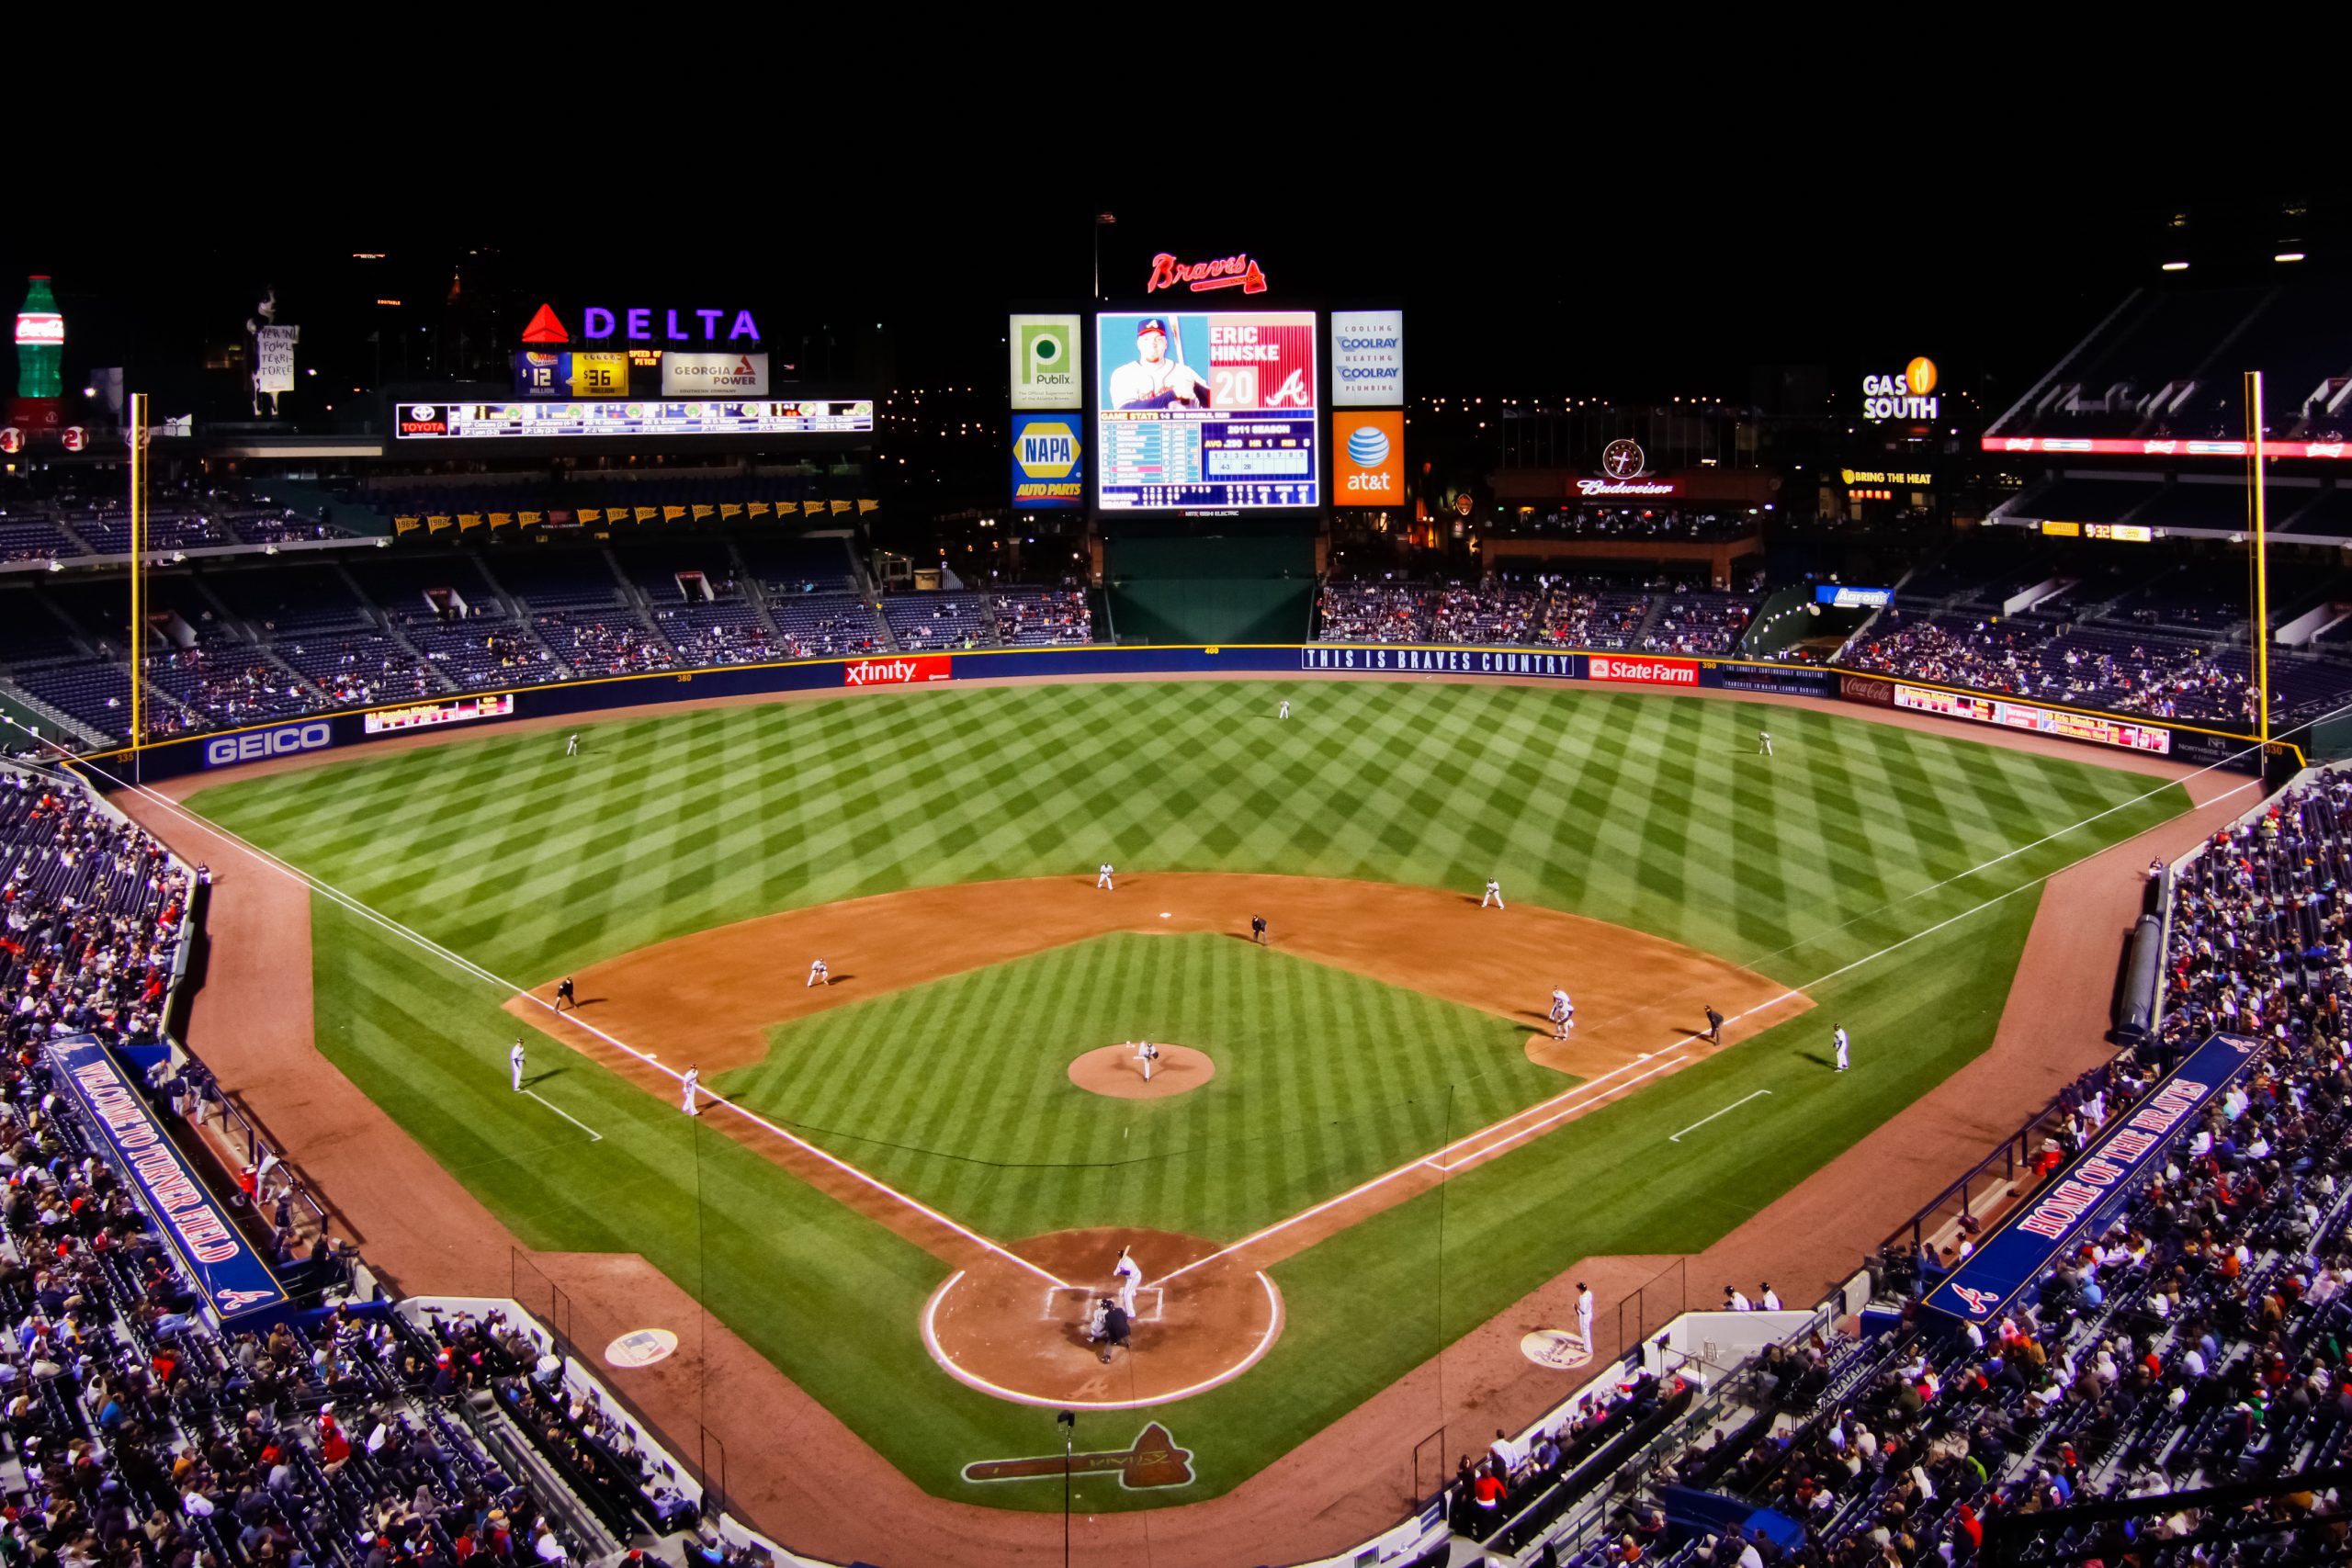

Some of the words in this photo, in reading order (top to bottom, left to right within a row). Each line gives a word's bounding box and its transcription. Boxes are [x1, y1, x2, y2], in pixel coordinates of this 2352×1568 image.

[1148, 254, 1246, 293] Braves
[584, 307, 760, 340] DELTA
[1210, 327, 1258, 344] ERIC
[1341, 338, 1399, 348] COOLRAY
[264, 341, 292, 352] FOWL
[1210, 344, 1279, 361] HINSKE
[534, 368, 551, 386] 12
[674, 366, 730, 376] GEORGIA
[1036, 374, 1070, 385] Publix
[1341, 367, 1399, 378] COOLRAY
[713, 377, 756, 385] POWER
[1215, 369, 1254, 404] 20
[1863, 375, 1907, 396] GAS
[1863, 397, 1938, 420] SOUTH
[401, 423, 446, 432] TOYOTA
[1251, 424, 1290, 434] SEASON
[0, 432, 22, 449] 41
[63, 430, 87, 447] 21
[1025, 438, 1070, 463] NAPA
[1347, 471, 1390, 491] at&t
[1855, 471, 1884, 482] BRING
[1887, 472, 1905, 483] THE
[1906, 473, 1931, 484] HEAT
[1016, 483, 1046, 496] AUTO
[1047, 483, 1081, 495] PARTS
[1577, 479, 1674, 495] Budweiser
[2086, 524, 2110, 538] 9:32
[1307, 649, 1353, 667] THIS
[1365, 650, 1385, 668] IS
[1398, 650, 1470, 671] BRAVES
[1482, 652, 1568, 674] COUNTRY
[847, 660, 917, 685] xfinity
[1611, 661, 1651, 679] State
[1653, 664, 1694, 682] Farm
[379, 710, 410, 718] Brandon
[2054, 713, 2069, 723] Eric
[2070, 716, 2095, 728] Hinske
[209, 724, 331, 764] GEICO
[2178, 743, 2218, 756] NORTHSIDE
[2265, 745, 2282, 755] 330
[118, 753, 133, 763] 335
[74, 1060, 146, 1138] WELCOME
[2128, 1078, 2209, 1134] BRAVES
[120, 1122, 159, 1148] TO
[2104, 1127, 2159, 1164] THE
[128, 1144, 202, 1214] TURNER
[2075, 1156, 2124, 1186] OF
[2018, 1180, 2104, 1240] HOME
[175, 1204, 239, 1263] FIELD
